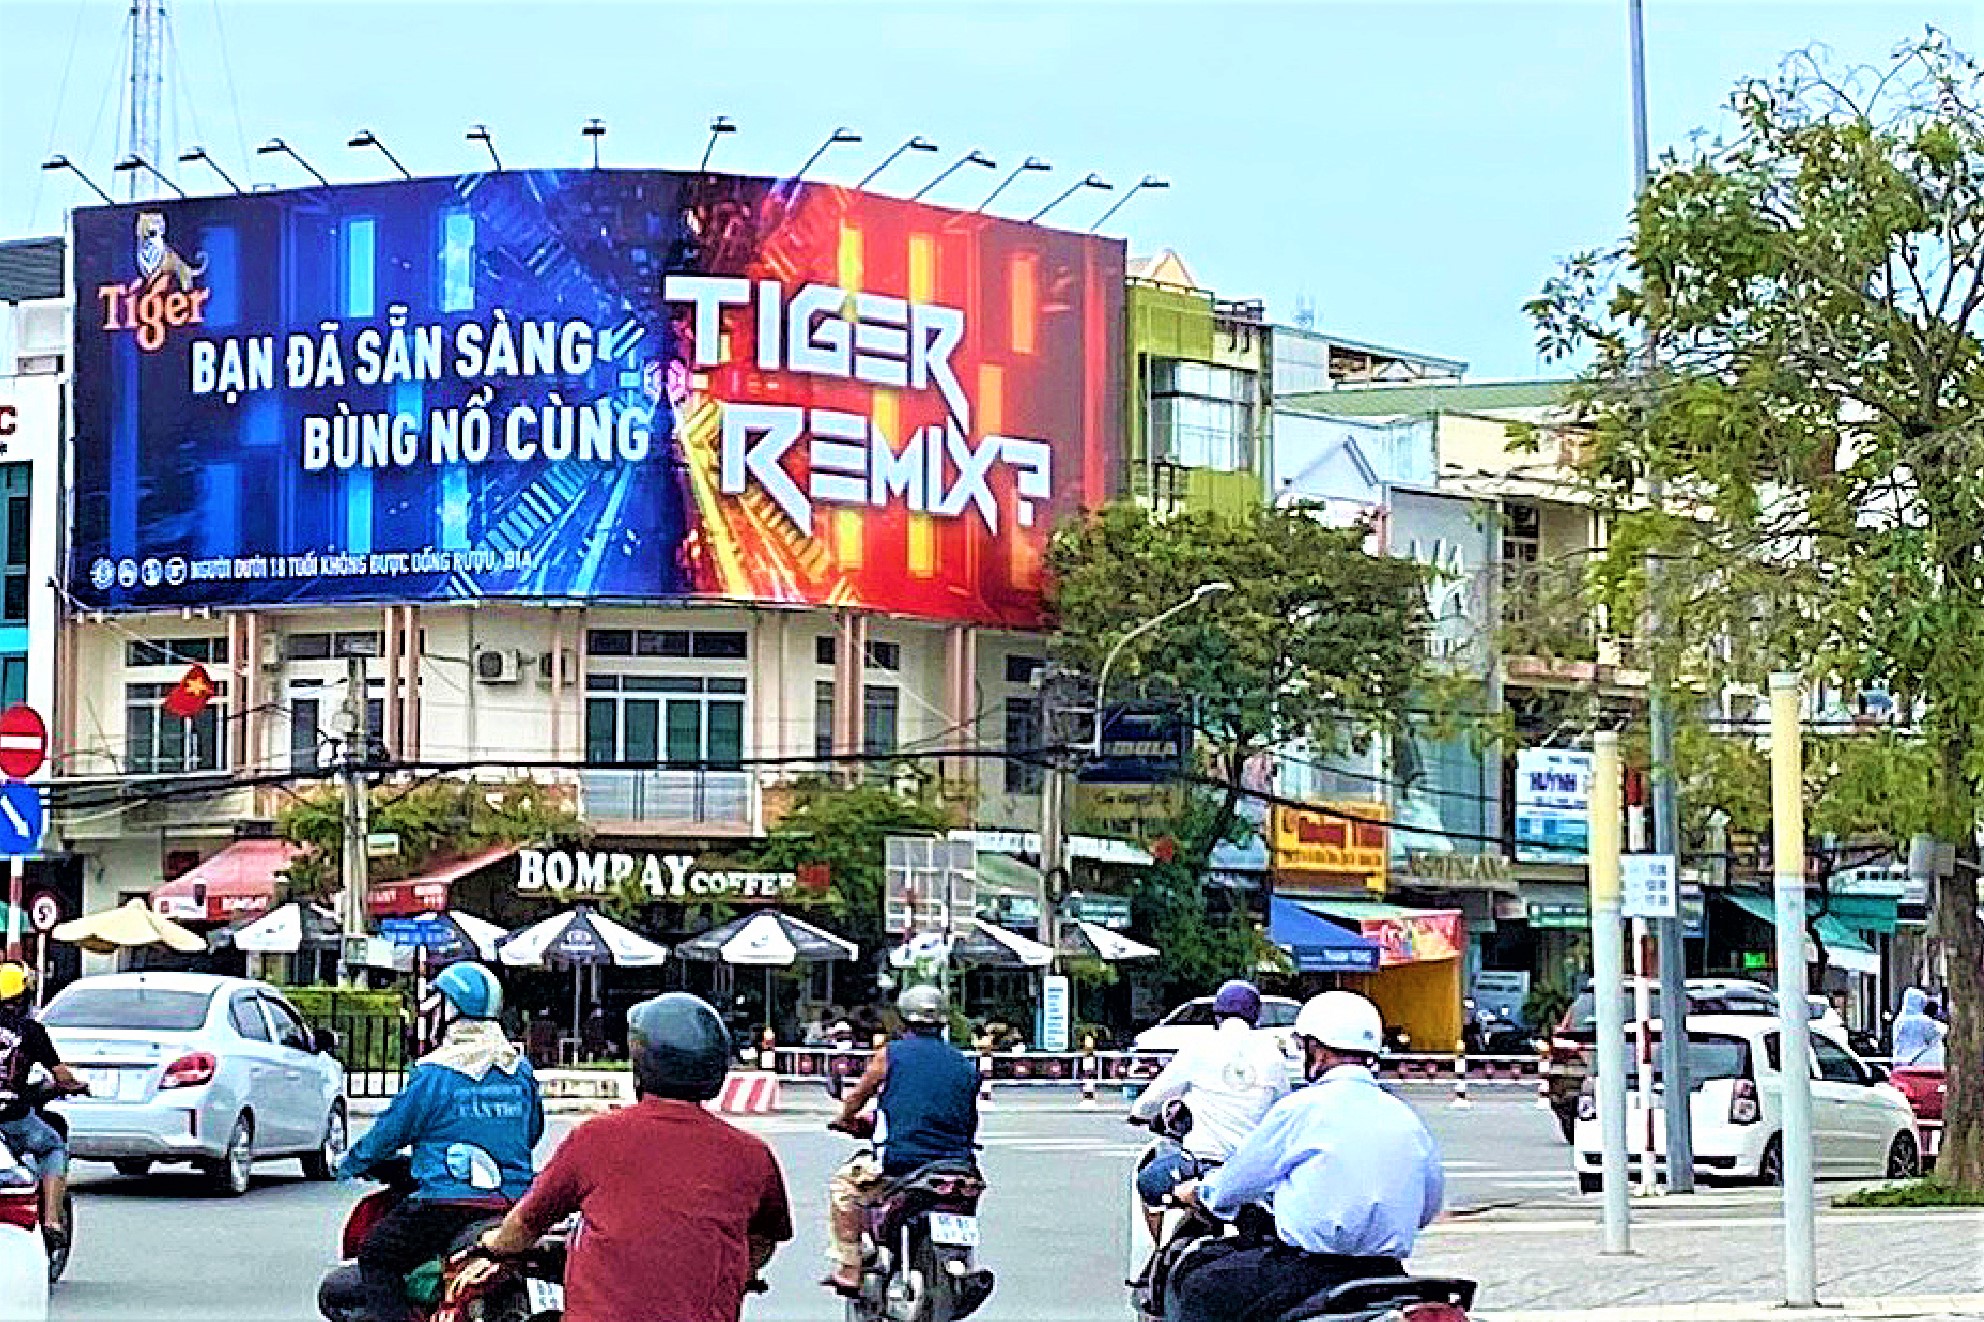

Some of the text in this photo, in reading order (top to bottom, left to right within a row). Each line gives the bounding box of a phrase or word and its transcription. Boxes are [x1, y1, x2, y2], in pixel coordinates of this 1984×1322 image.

[98, 279, 210, 352] Tiger
[191, 305, 593, 404] BẠN ĐÃ SẴN SÀNG
[665, 275, 970, 437] TIGER
[303, 385, 651, 470] BÙNG NỔ CÙNG
[720, 402, 1051, 536] REMIX?
